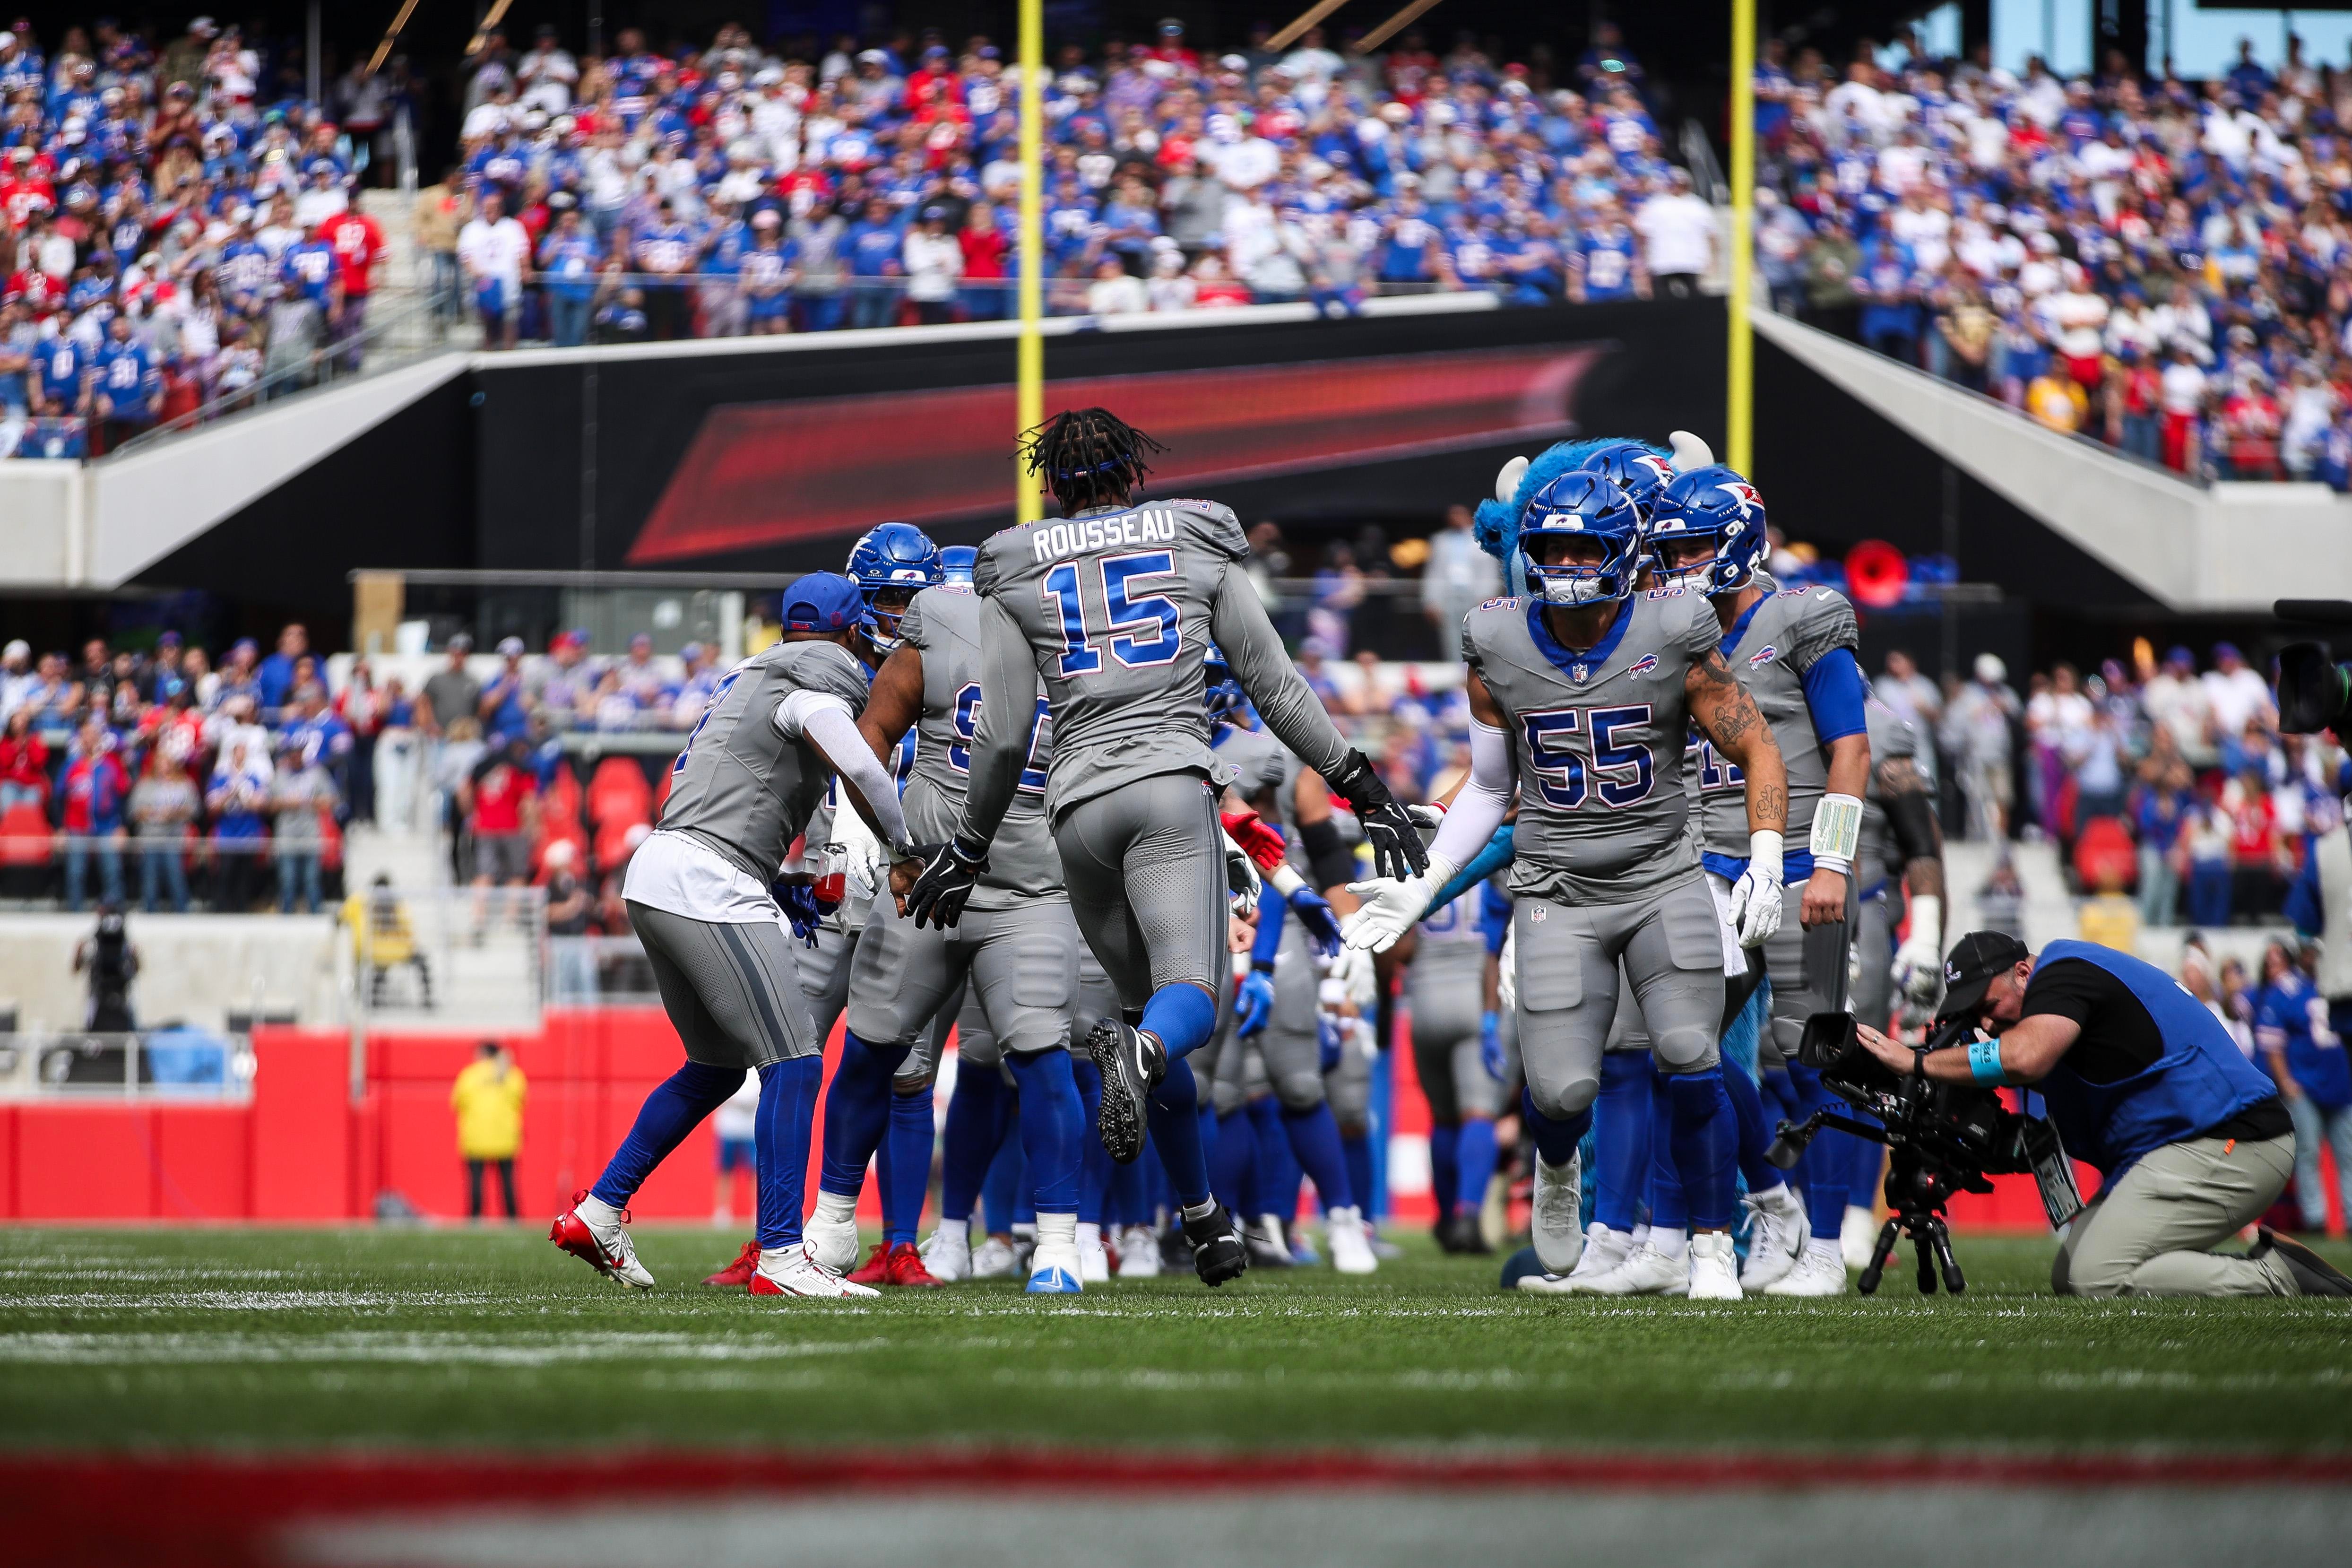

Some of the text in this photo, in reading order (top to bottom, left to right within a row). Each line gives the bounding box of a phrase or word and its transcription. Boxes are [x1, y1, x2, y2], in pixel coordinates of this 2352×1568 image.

[1032, 509, 1177, 563] ROUSSEAU
[1040, 548, 1183, 679] 15
[1517, 702, 1655, 811] 55
[1700, 738, 1747, 790] 1
